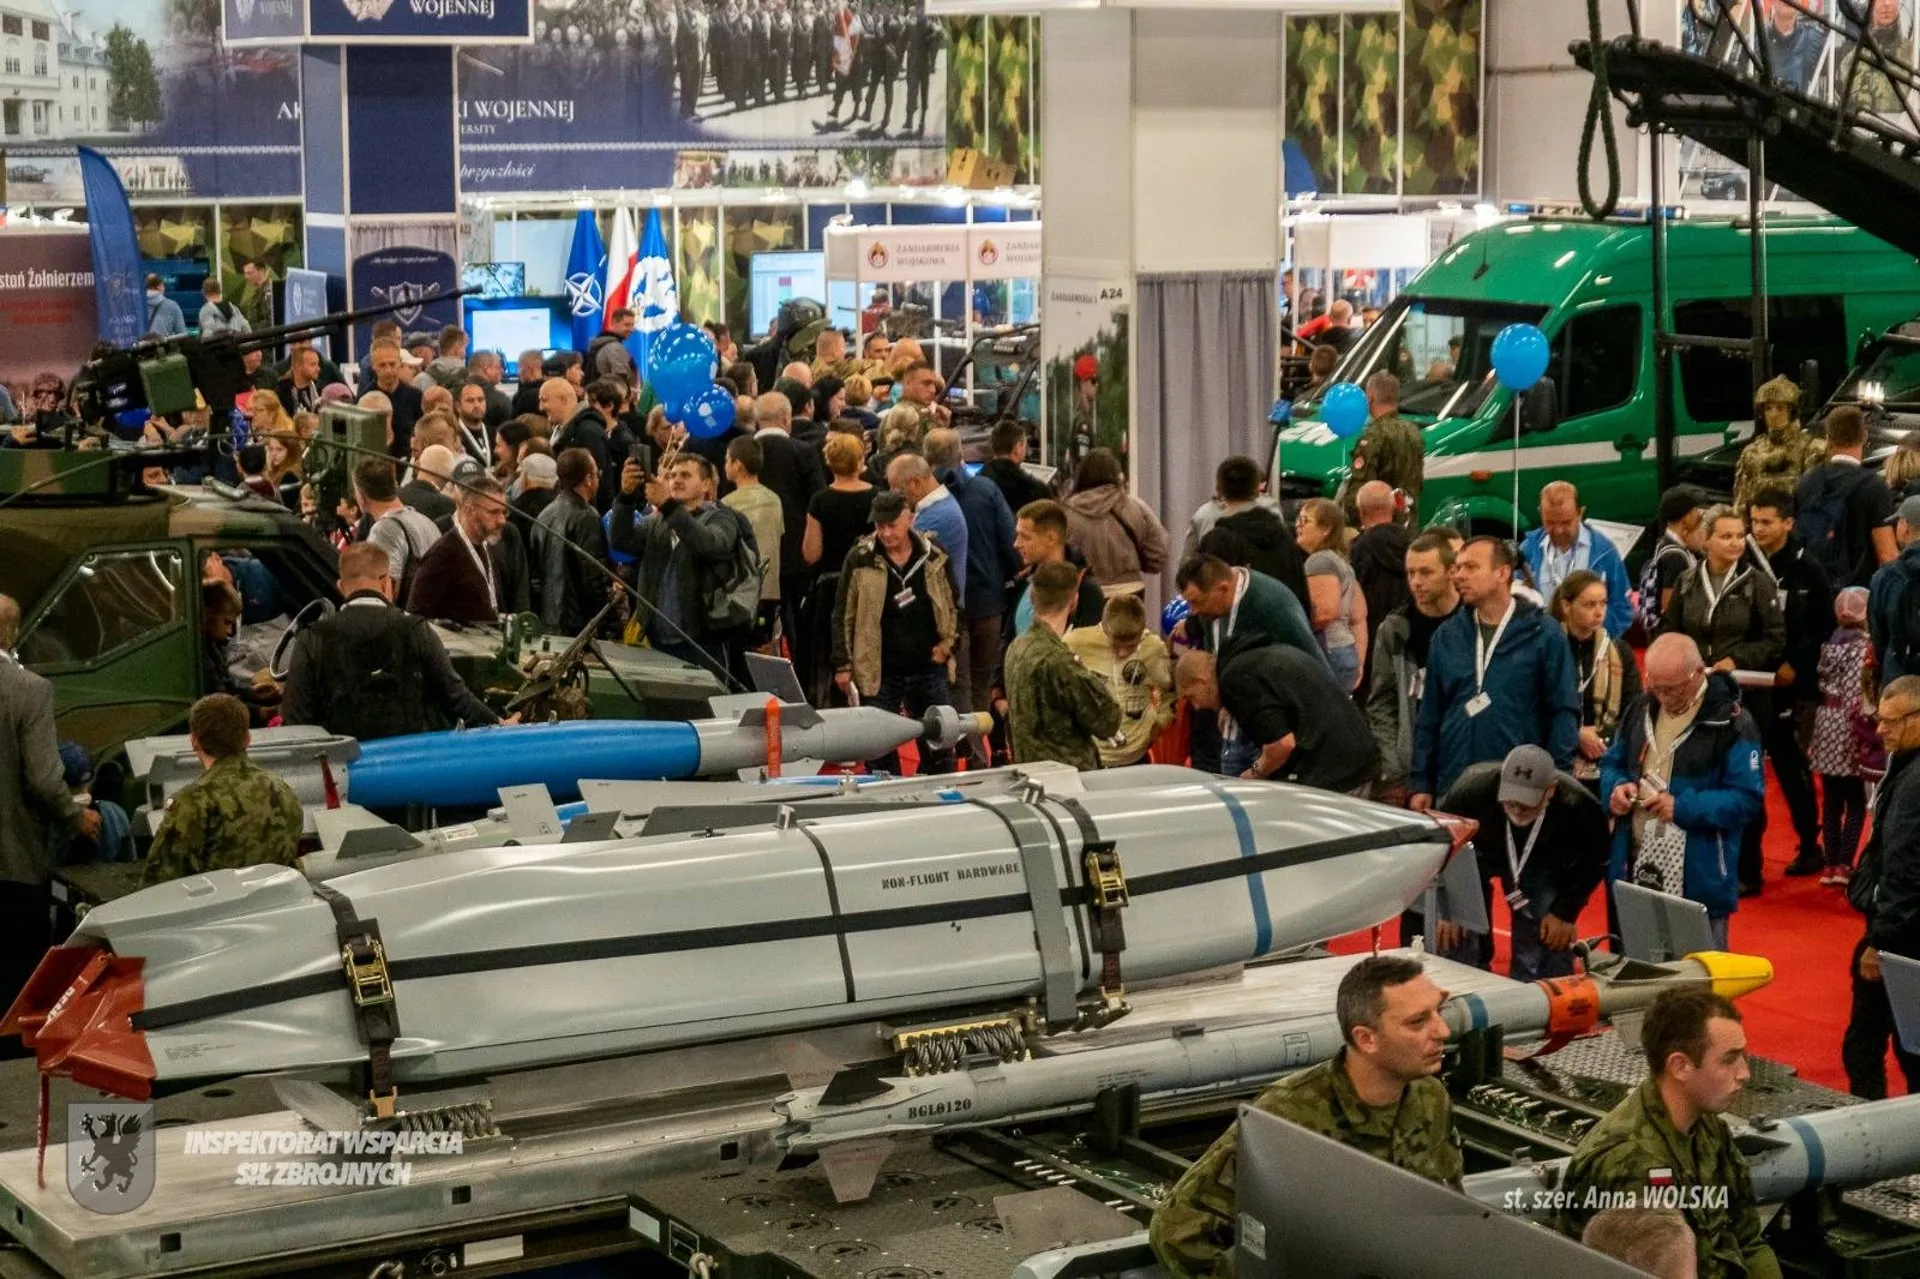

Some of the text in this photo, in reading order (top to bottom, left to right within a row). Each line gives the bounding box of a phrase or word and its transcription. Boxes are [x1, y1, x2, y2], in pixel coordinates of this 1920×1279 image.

[409, 0, 496, 19] WOJENNEJ
[474, 100, 574, 122] WOJENNEJ
[28, 267, 95, 288] Żołnierzem
[1100, 287, 1123, 300] A24
[881, 862, 1021, 890] NON-FLIGHT HARDWARE
